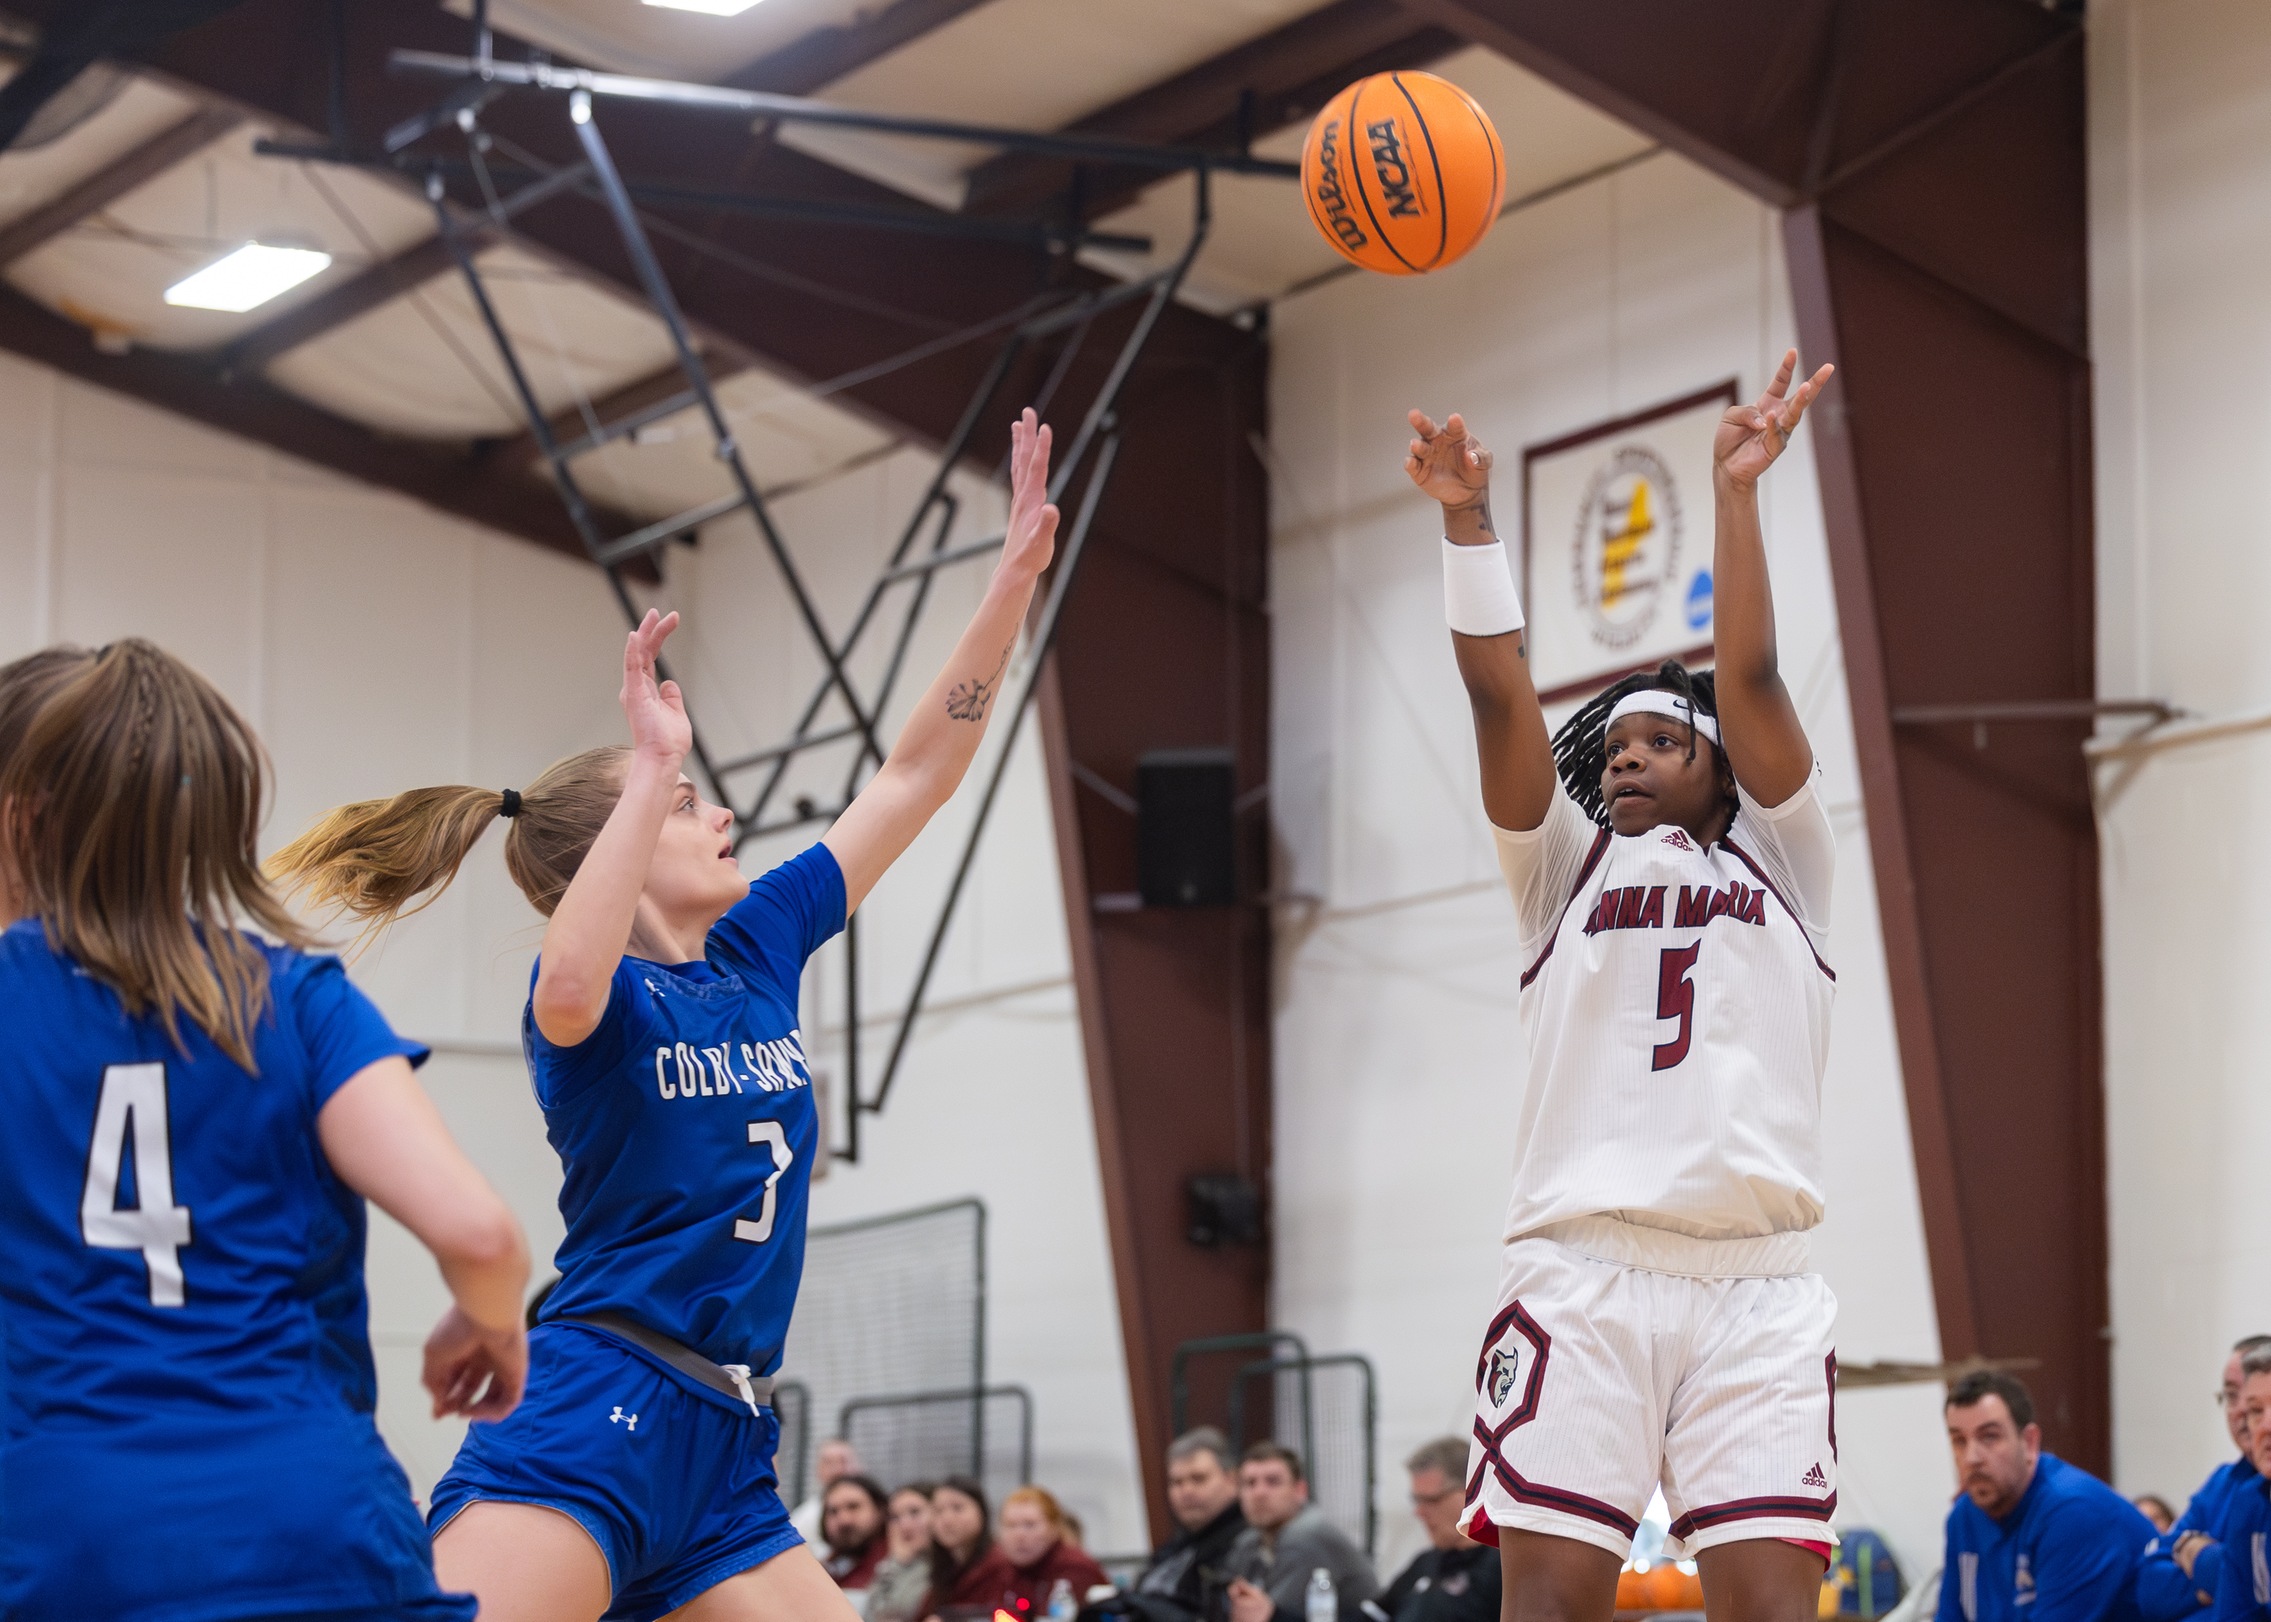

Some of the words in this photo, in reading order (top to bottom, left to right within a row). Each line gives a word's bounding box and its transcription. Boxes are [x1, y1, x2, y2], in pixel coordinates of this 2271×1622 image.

[1318, 119, 1368, 252] Wilson
[1365, 116, 1421, 220] NCAA
[1661, 837, 1694, 852] adidas
[1581, 885, 1669, 938] ANNA
[1651, 937, 1702, 1073] 5
[79, 1060, 194, 1308] 4
[733, 1119, 794, 1244] 3
